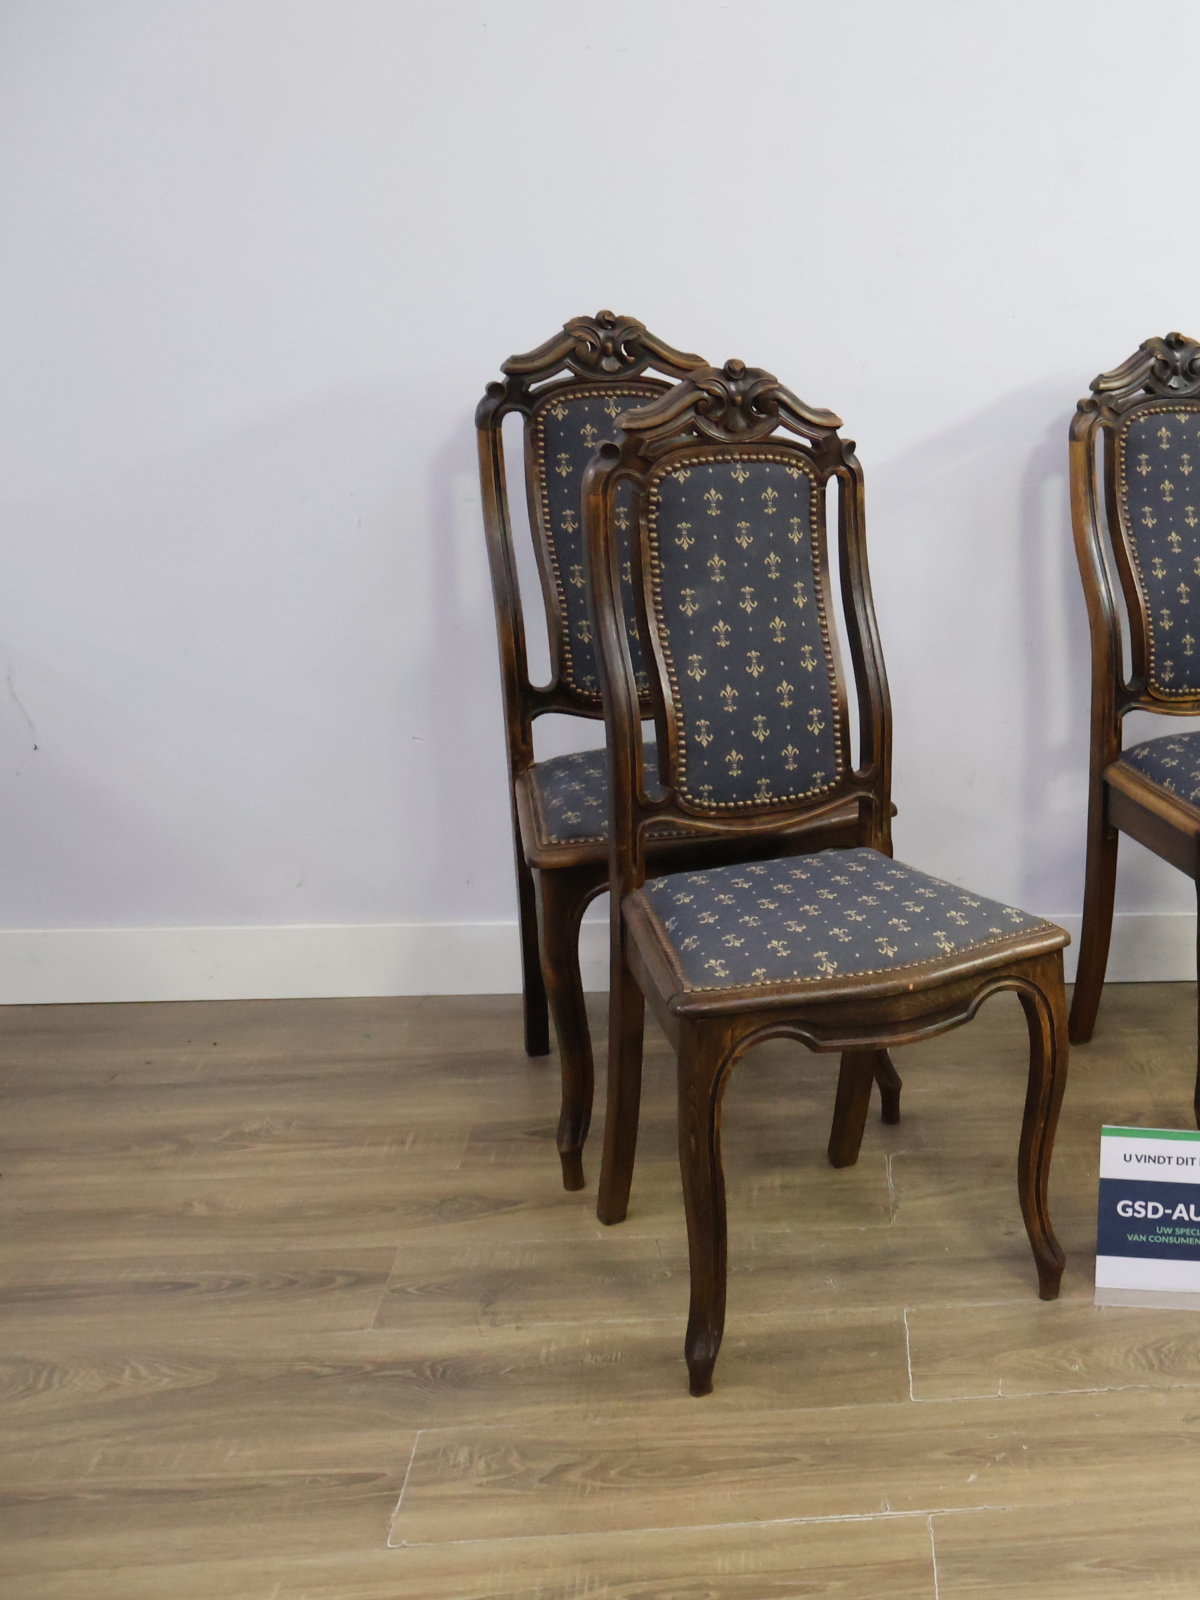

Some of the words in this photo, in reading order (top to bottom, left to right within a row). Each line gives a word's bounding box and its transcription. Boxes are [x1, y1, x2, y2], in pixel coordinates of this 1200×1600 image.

[1123, 1153, 1132, 1163] U
[1135, 1154, 1173, 1165] VINDT
[1176, 1156, 1196, 1167] DIT
[1156, 1226, 1173, 1235] UW
[1127, 1233, 1146, 1242] VAN
